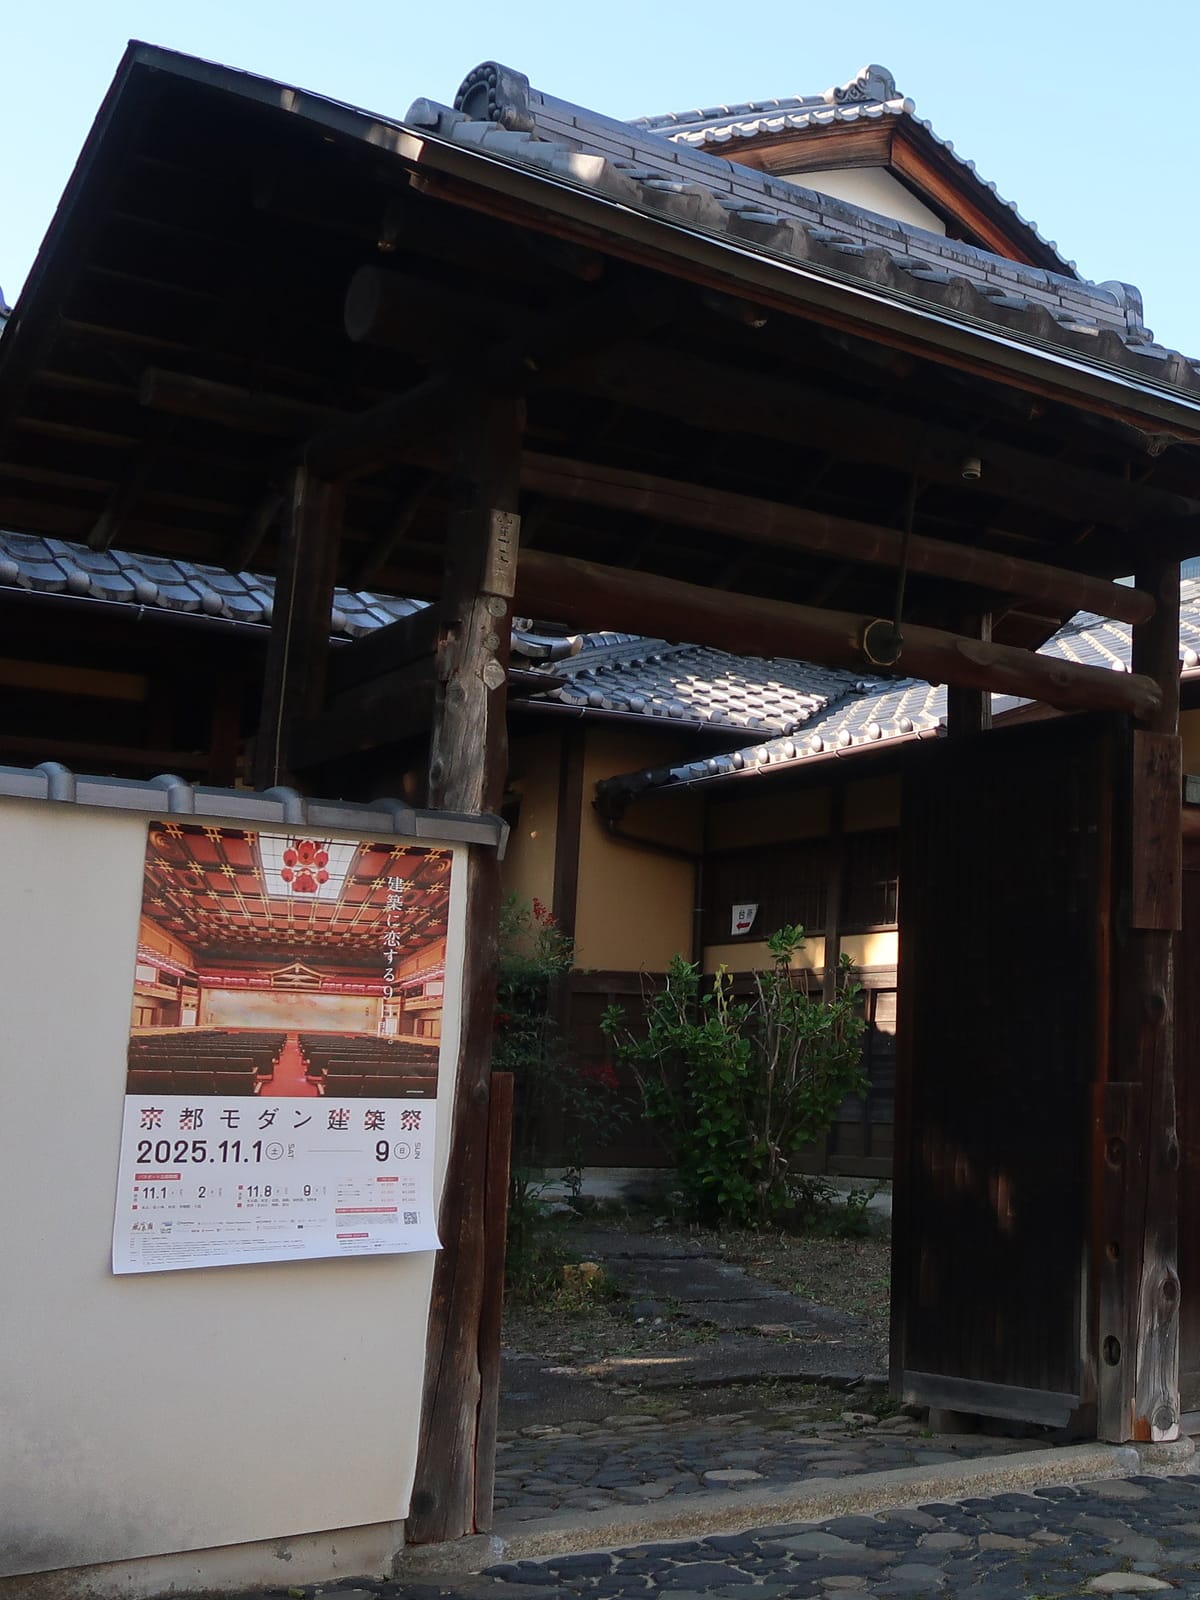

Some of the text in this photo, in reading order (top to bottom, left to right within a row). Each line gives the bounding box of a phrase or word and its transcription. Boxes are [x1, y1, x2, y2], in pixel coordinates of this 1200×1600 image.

[140, 1106, 422, 1131] 京都モダン建築祭
[136, 1140, 262, 1164] 2025.11.1
[287, 1143, 296, 1159] SAT
[375, 1140, 390, 1162] 9
[414, 1142, 422, 1160] SUN
[143, 1186, 167, 1199] 11.1
[198, 1186, 206, 1198] 2
[247, 1185, 272, 1197] 11.8
[303, 1184, 311, 1196] 9
